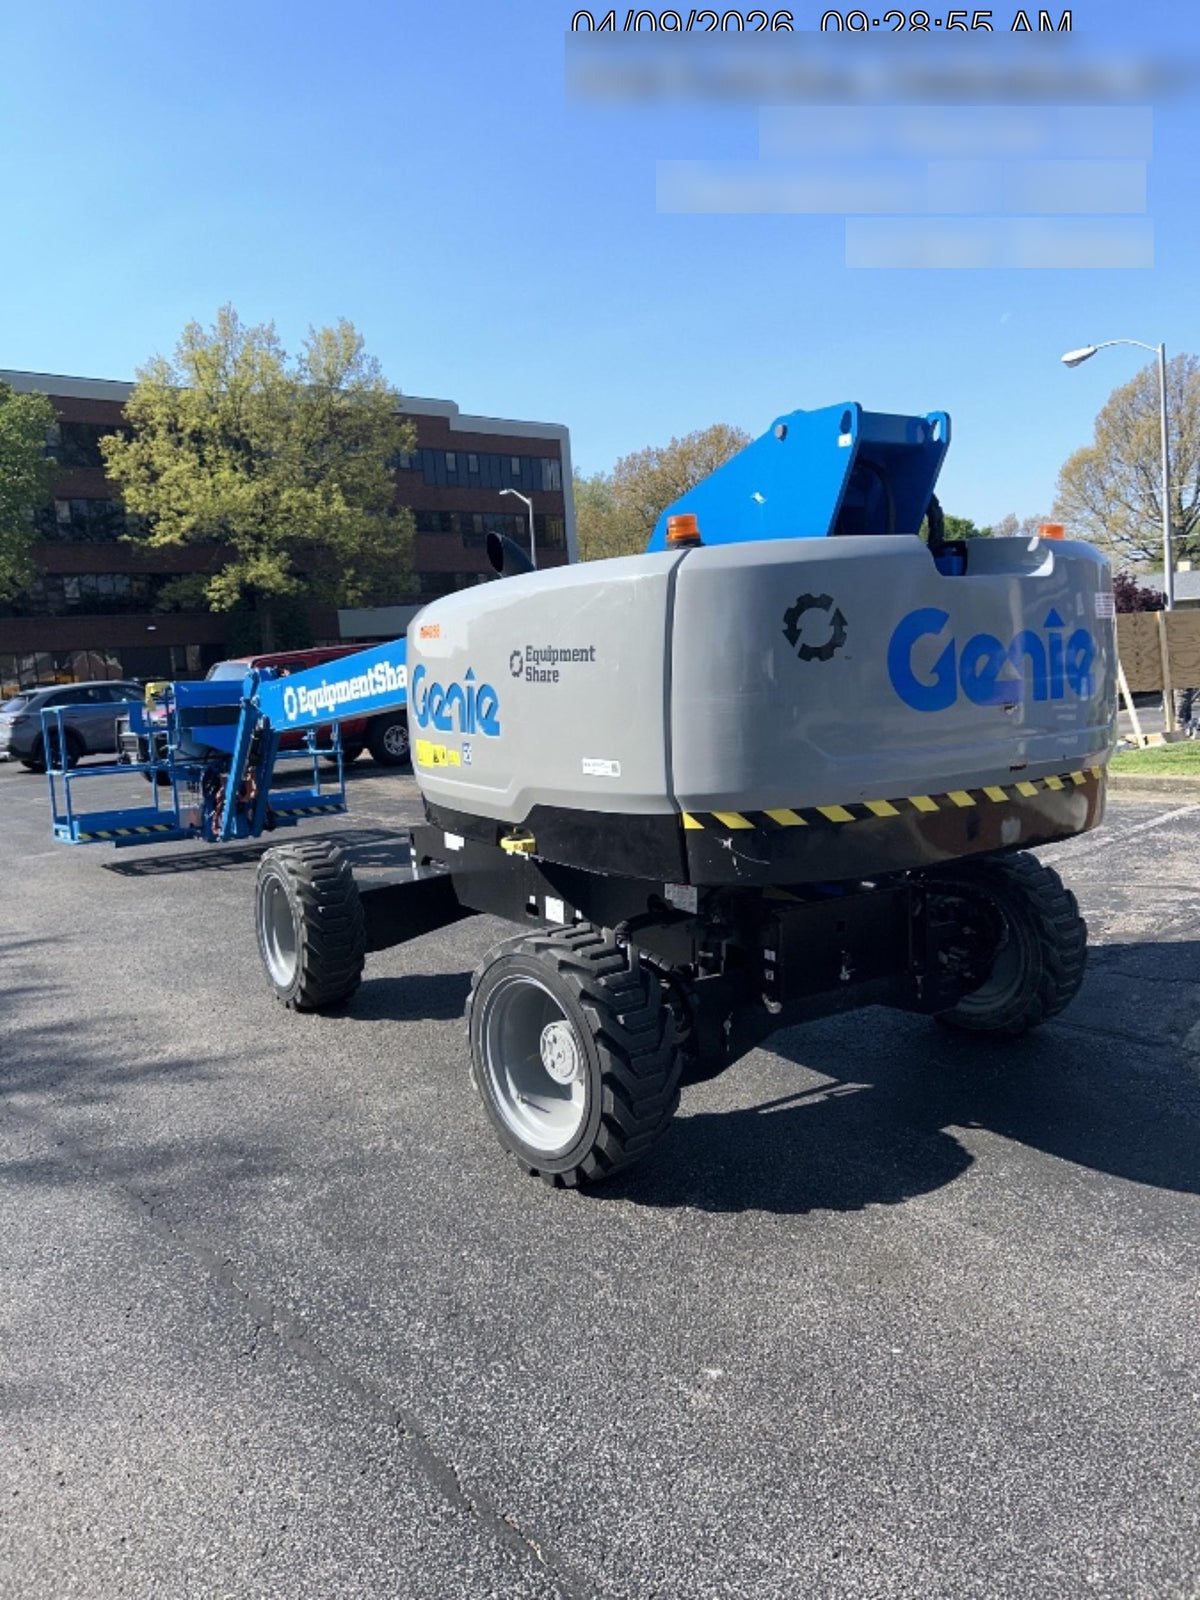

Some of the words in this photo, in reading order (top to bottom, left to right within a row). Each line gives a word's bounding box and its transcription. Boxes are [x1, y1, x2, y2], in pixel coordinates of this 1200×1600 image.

[525, 644, 596, 665] Equipment
[525, 665, 560, 682] Share
[887, 607, 1096, 712] Genie
[412, 664, 500, 737] Genie
